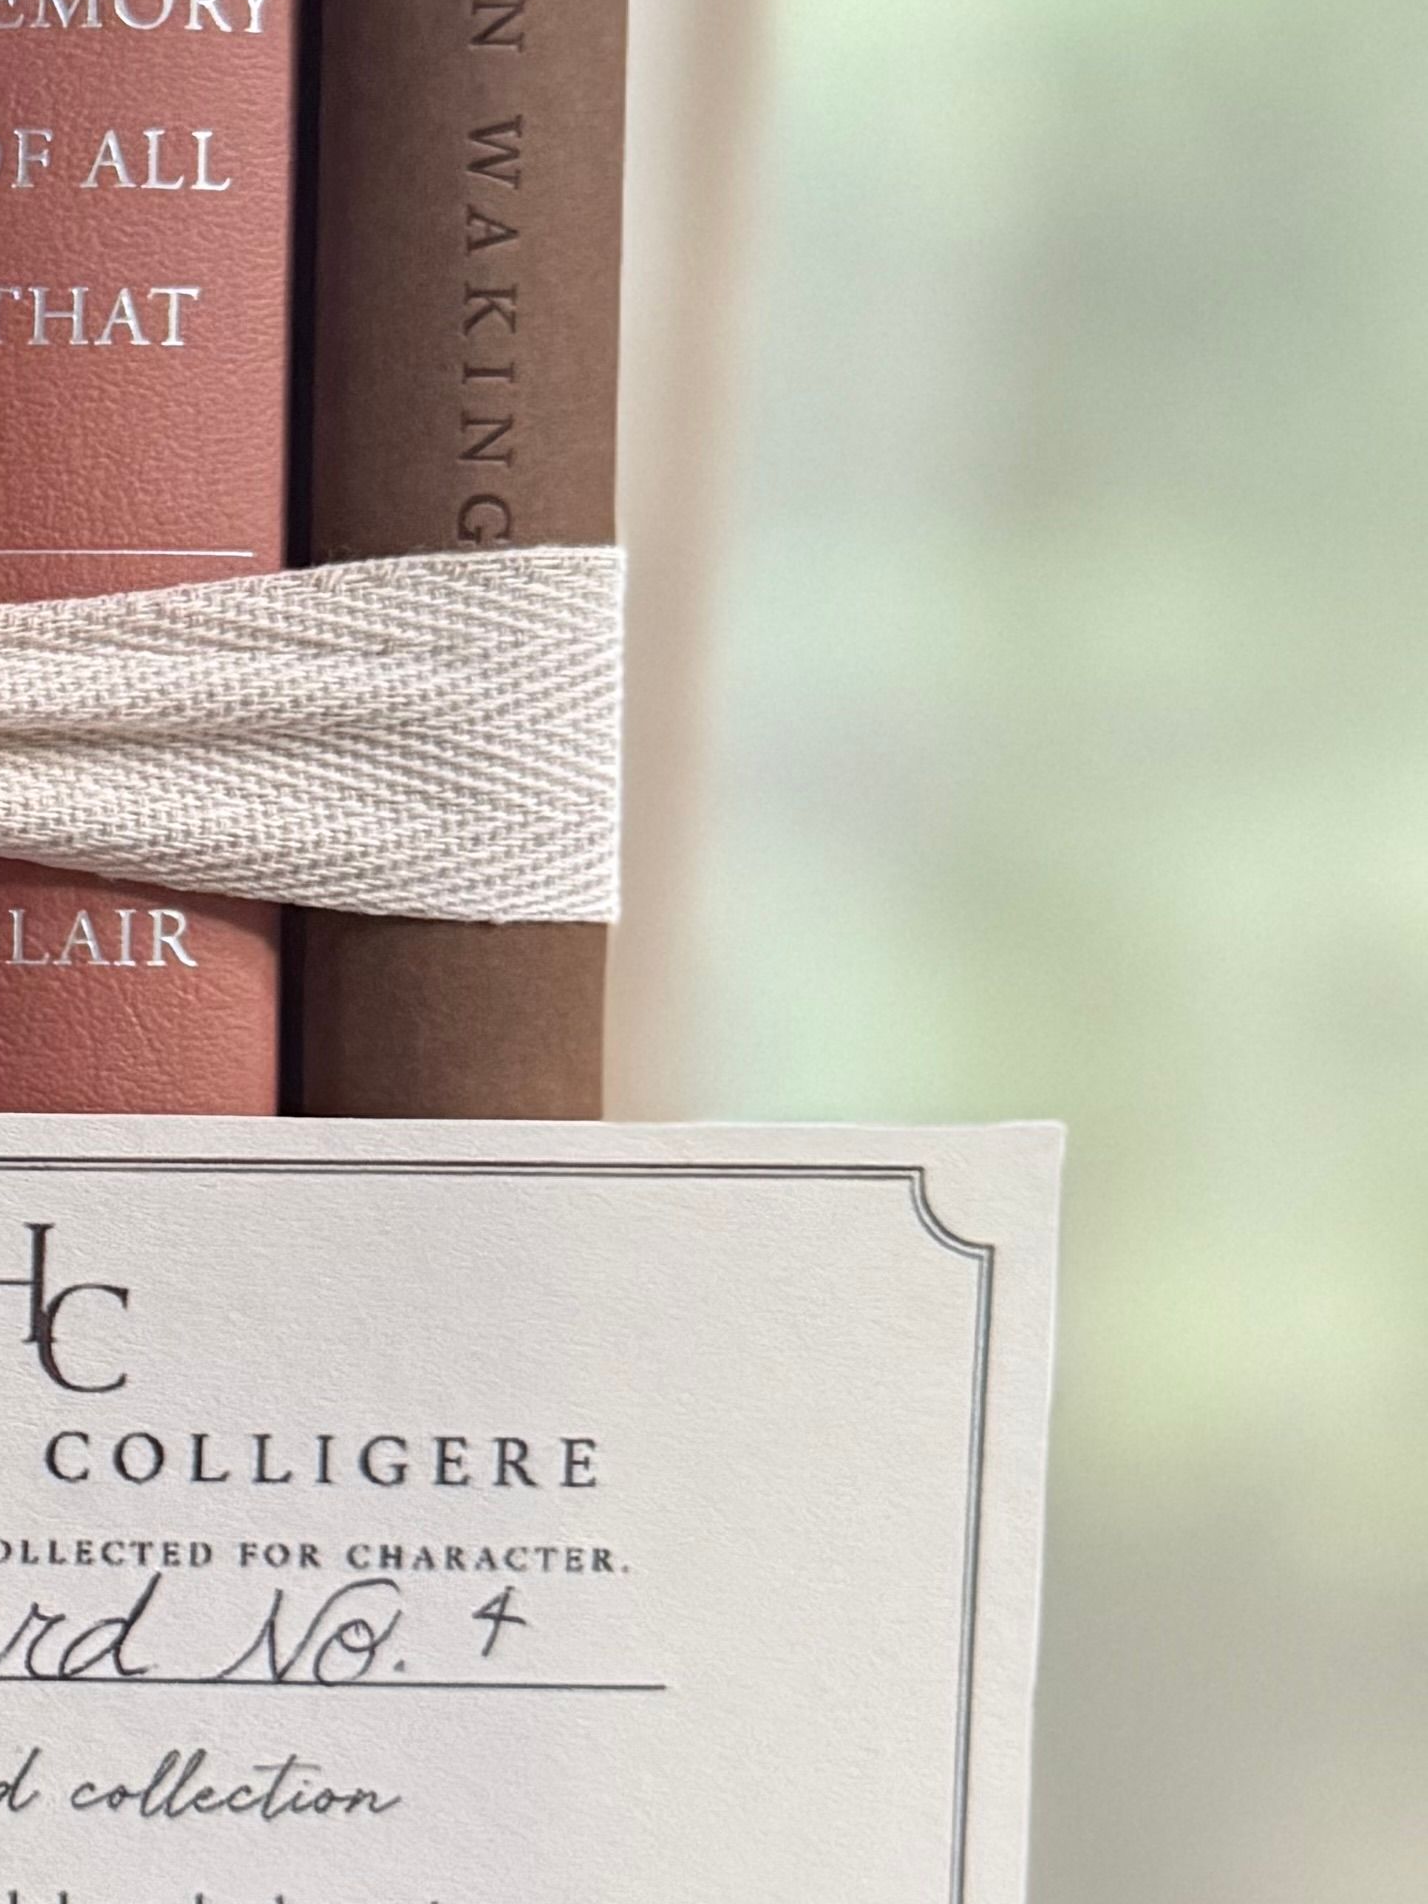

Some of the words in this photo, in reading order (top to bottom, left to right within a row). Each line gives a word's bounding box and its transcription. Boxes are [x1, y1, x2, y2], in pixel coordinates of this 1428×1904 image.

[81, 128, 233, 193] ALL
[457, 114, 525, 545] WAKING
[43, 1430, 600, 1489] COLLIGERE
[240, 1541, 321, 1568] FOR
[346, 1541, 631, 1574] CHARACTER.
[216, 1577, 407, 1686] No.
[471, 1585, 527, 1658] 4
[69, 1748, 403, 1821] collection
